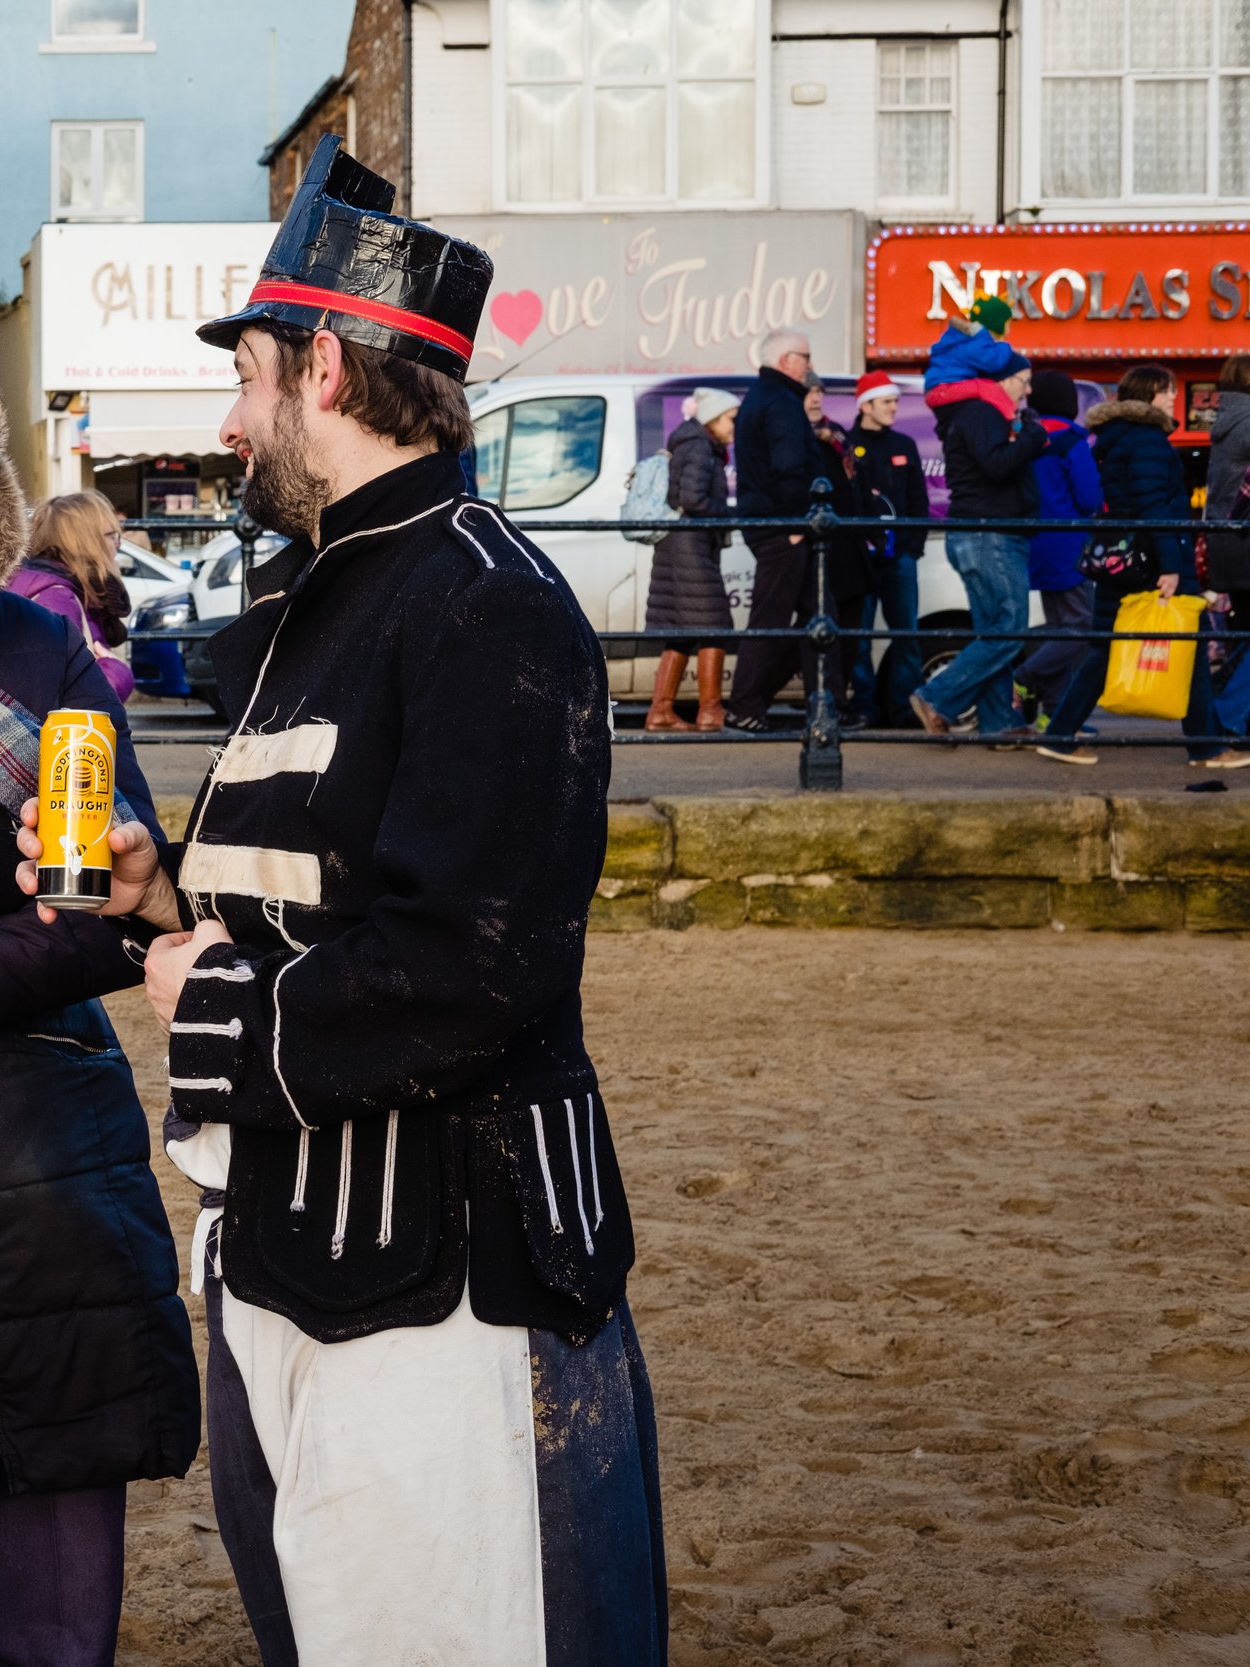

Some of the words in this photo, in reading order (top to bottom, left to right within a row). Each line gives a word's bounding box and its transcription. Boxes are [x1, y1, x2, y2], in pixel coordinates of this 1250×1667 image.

[626, 228, 660, 275] To
[91, 260, 251, 328] MILLE
[638, 240, 837, 369] Fudge
[926, 260, 1191, 321] NIKOLAS
[1209, 260, 1250, 321] S
[65, 366, 91, 378] Hot
[108, 366, 139, 378] Cold
[143, 366, 188, 378] Drinks
[54, 747, 108, 784] BODDINGTONS
[50, 800, 109, 811] DRAUGHT
[62, 813, 98, 821] BTTER
